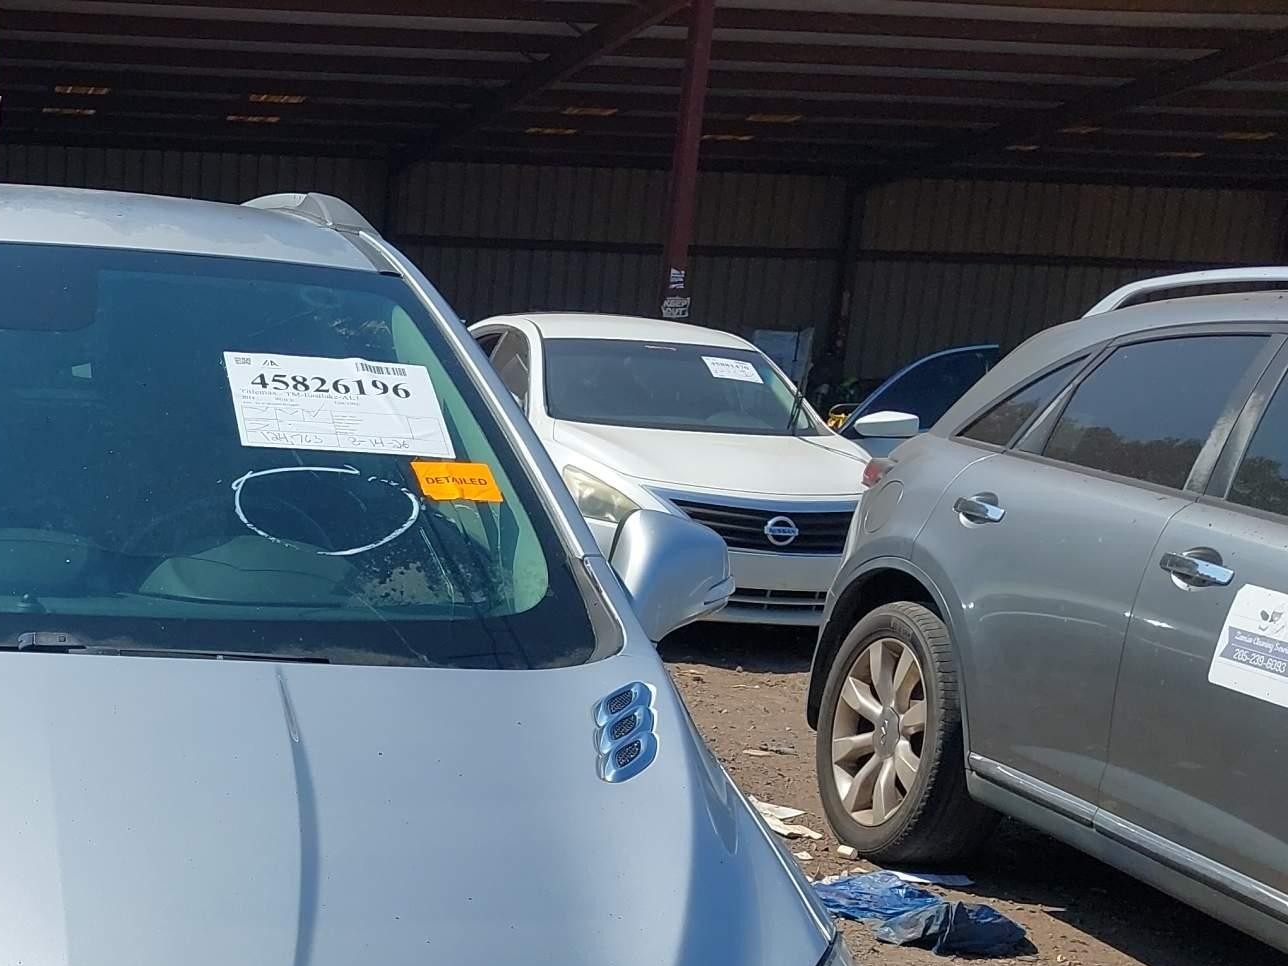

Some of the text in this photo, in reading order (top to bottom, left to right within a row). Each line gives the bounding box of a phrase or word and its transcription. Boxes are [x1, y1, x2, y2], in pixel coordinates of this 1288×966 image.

[663, 299, 689, 308] KEEP
[664, 308, 687, 316] OUT
[250, 372, 411, 399] 45826196
[425, 476, 488, 486] DETAILED
